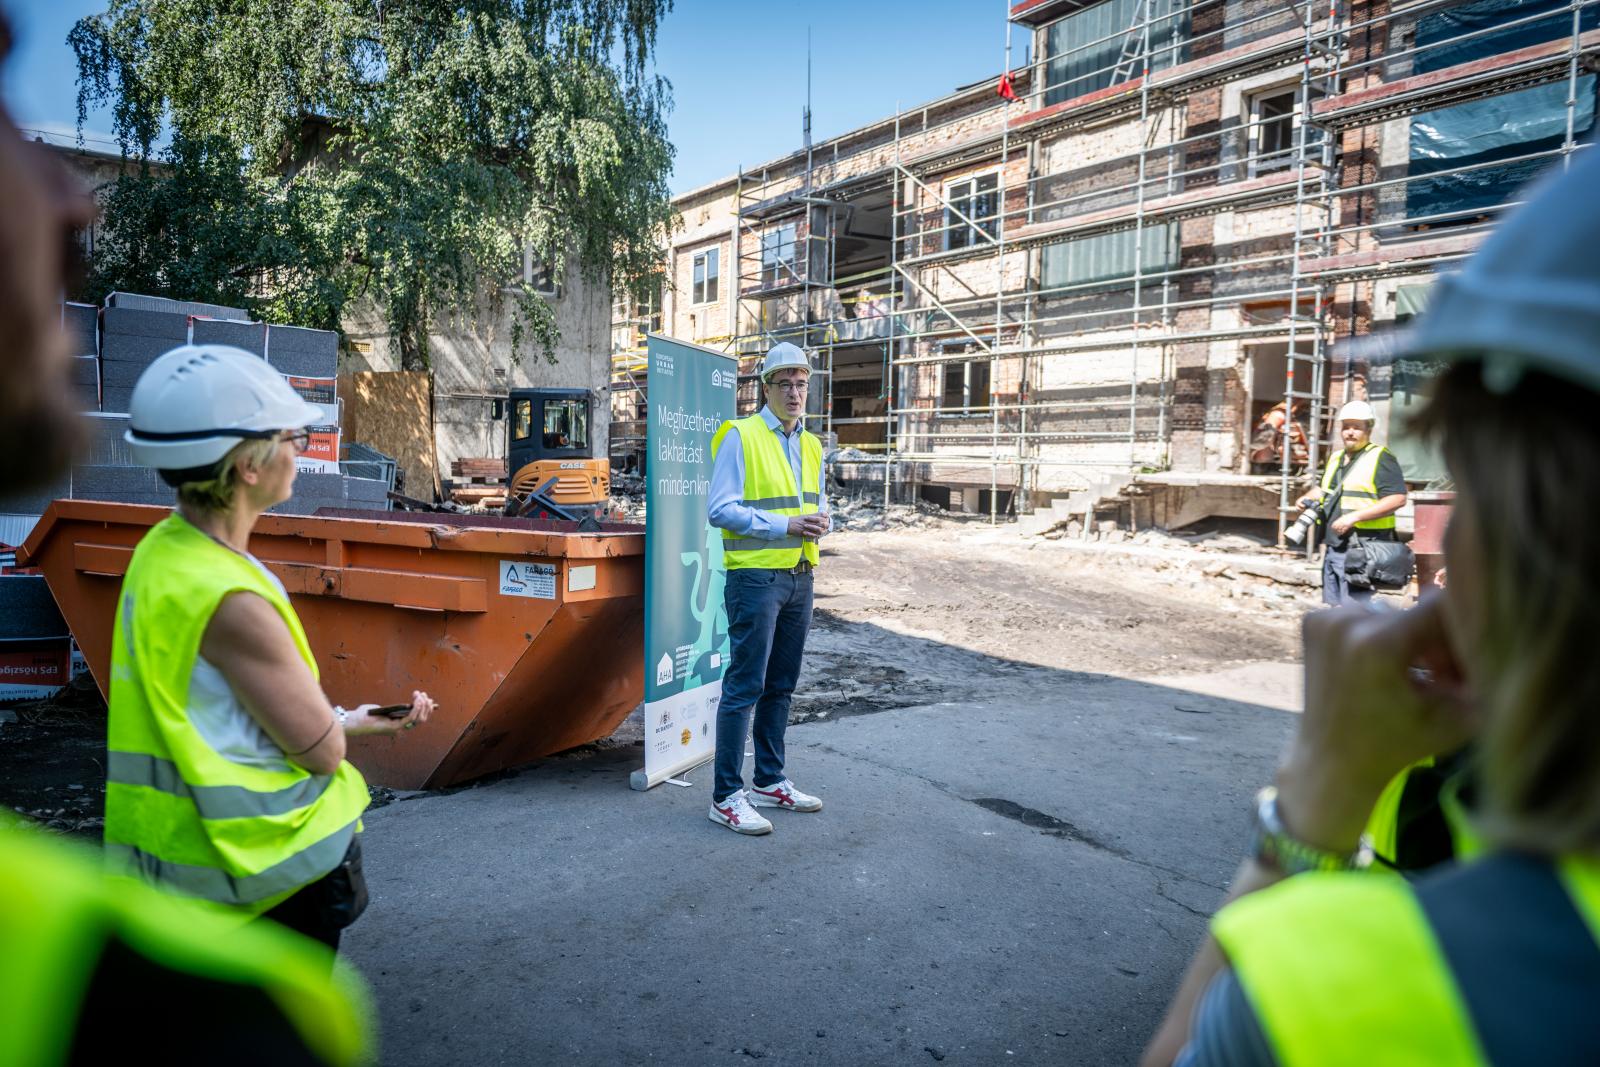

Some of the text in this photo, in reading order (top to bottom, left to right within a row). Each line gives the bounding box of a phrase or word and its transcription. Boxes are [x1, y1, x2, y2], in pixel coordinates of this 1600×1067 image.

[658, 404, 721, 435] Megfizethető
[658, 437, 704, 464] lakhatást
[659, 471, 710, 496] mindenkin
[0, 665, 58, 675] EPS hőszige
[659, 668, 672, 683] AHA
